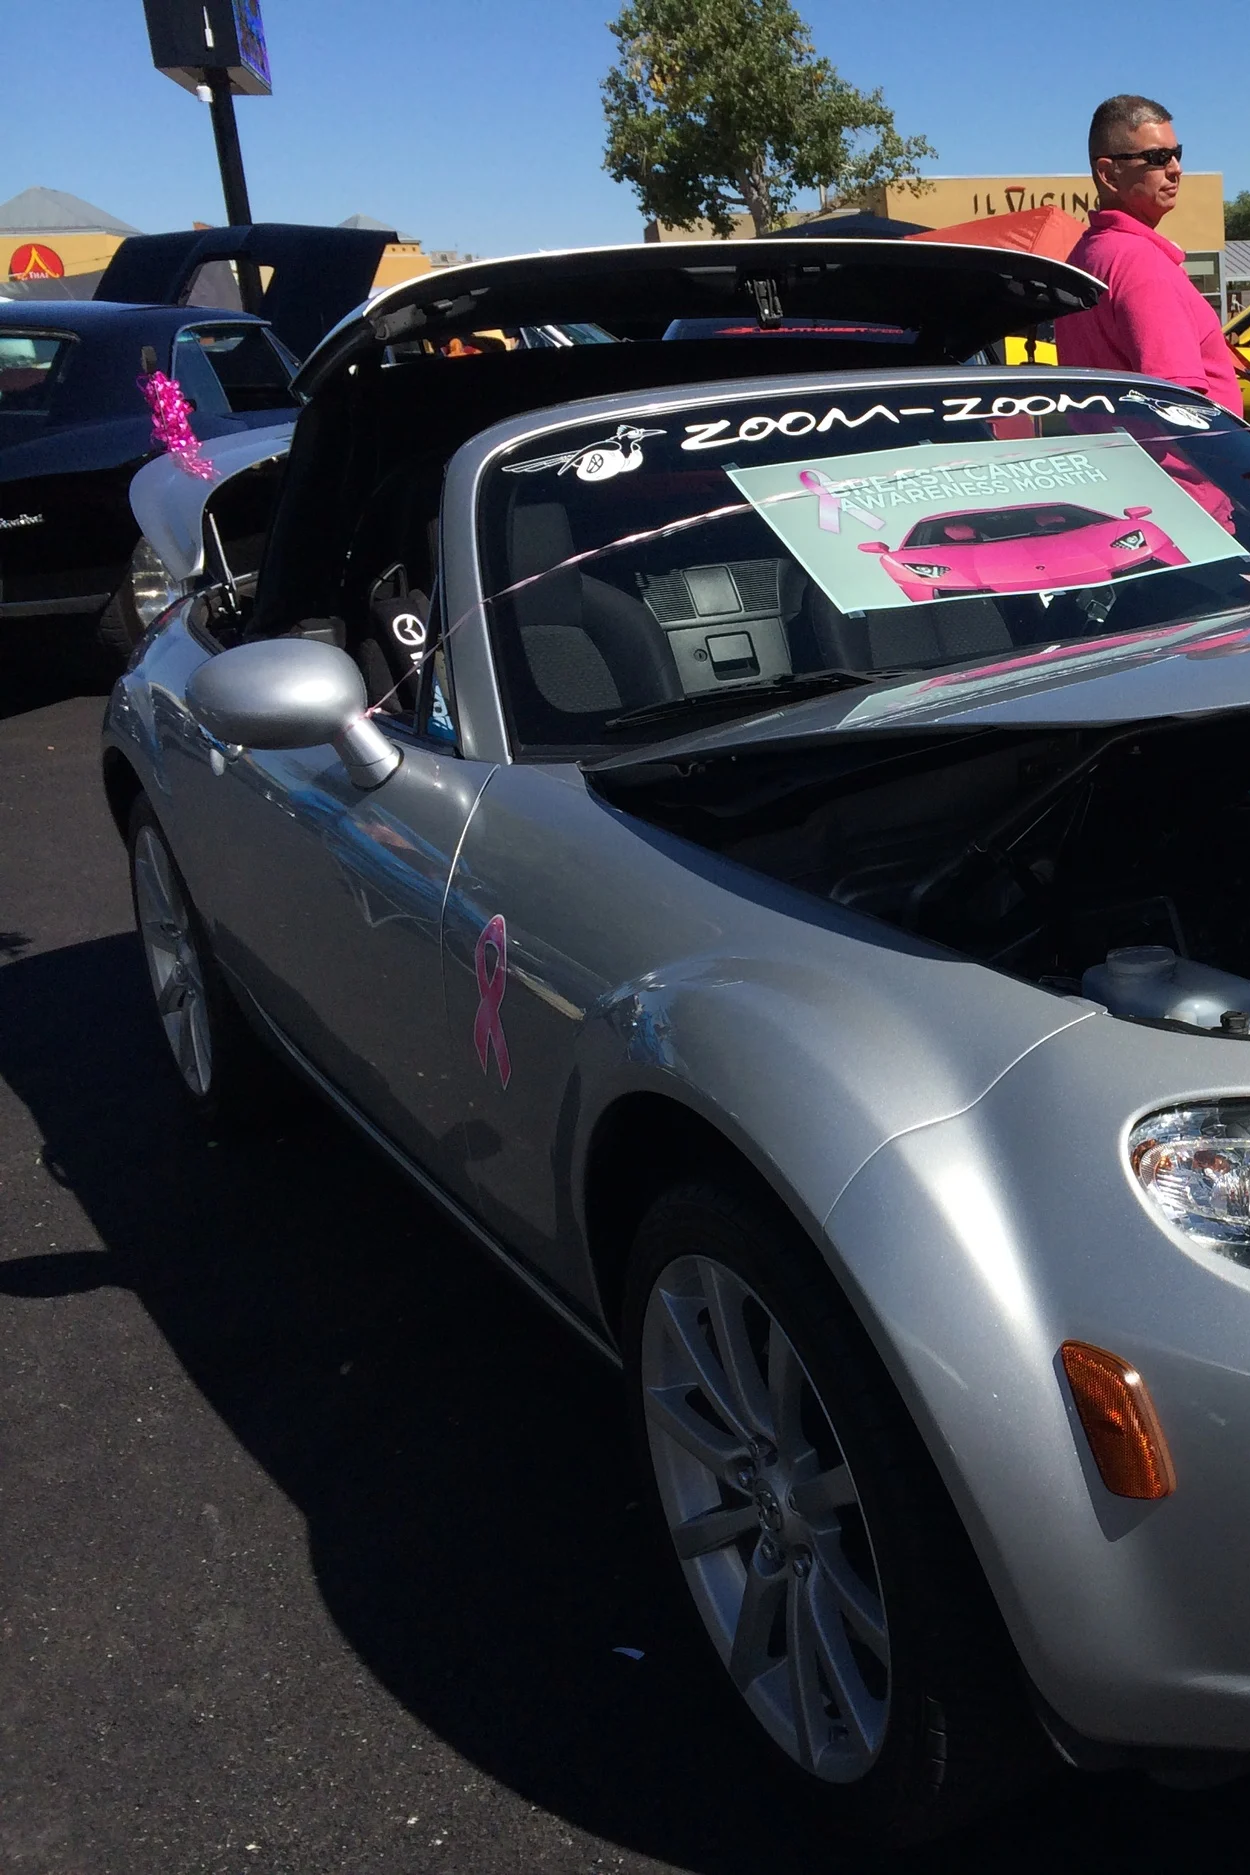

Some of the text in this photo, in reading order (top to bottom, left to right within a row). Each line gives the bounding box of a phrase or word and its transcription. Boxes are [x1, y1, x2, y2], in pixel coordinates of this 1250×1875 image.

[973, 193, 997, 215] IL
[963, 454, 1096, 481] CANCER
[839, 469, 1108, 512] AWARENESS MONTH
